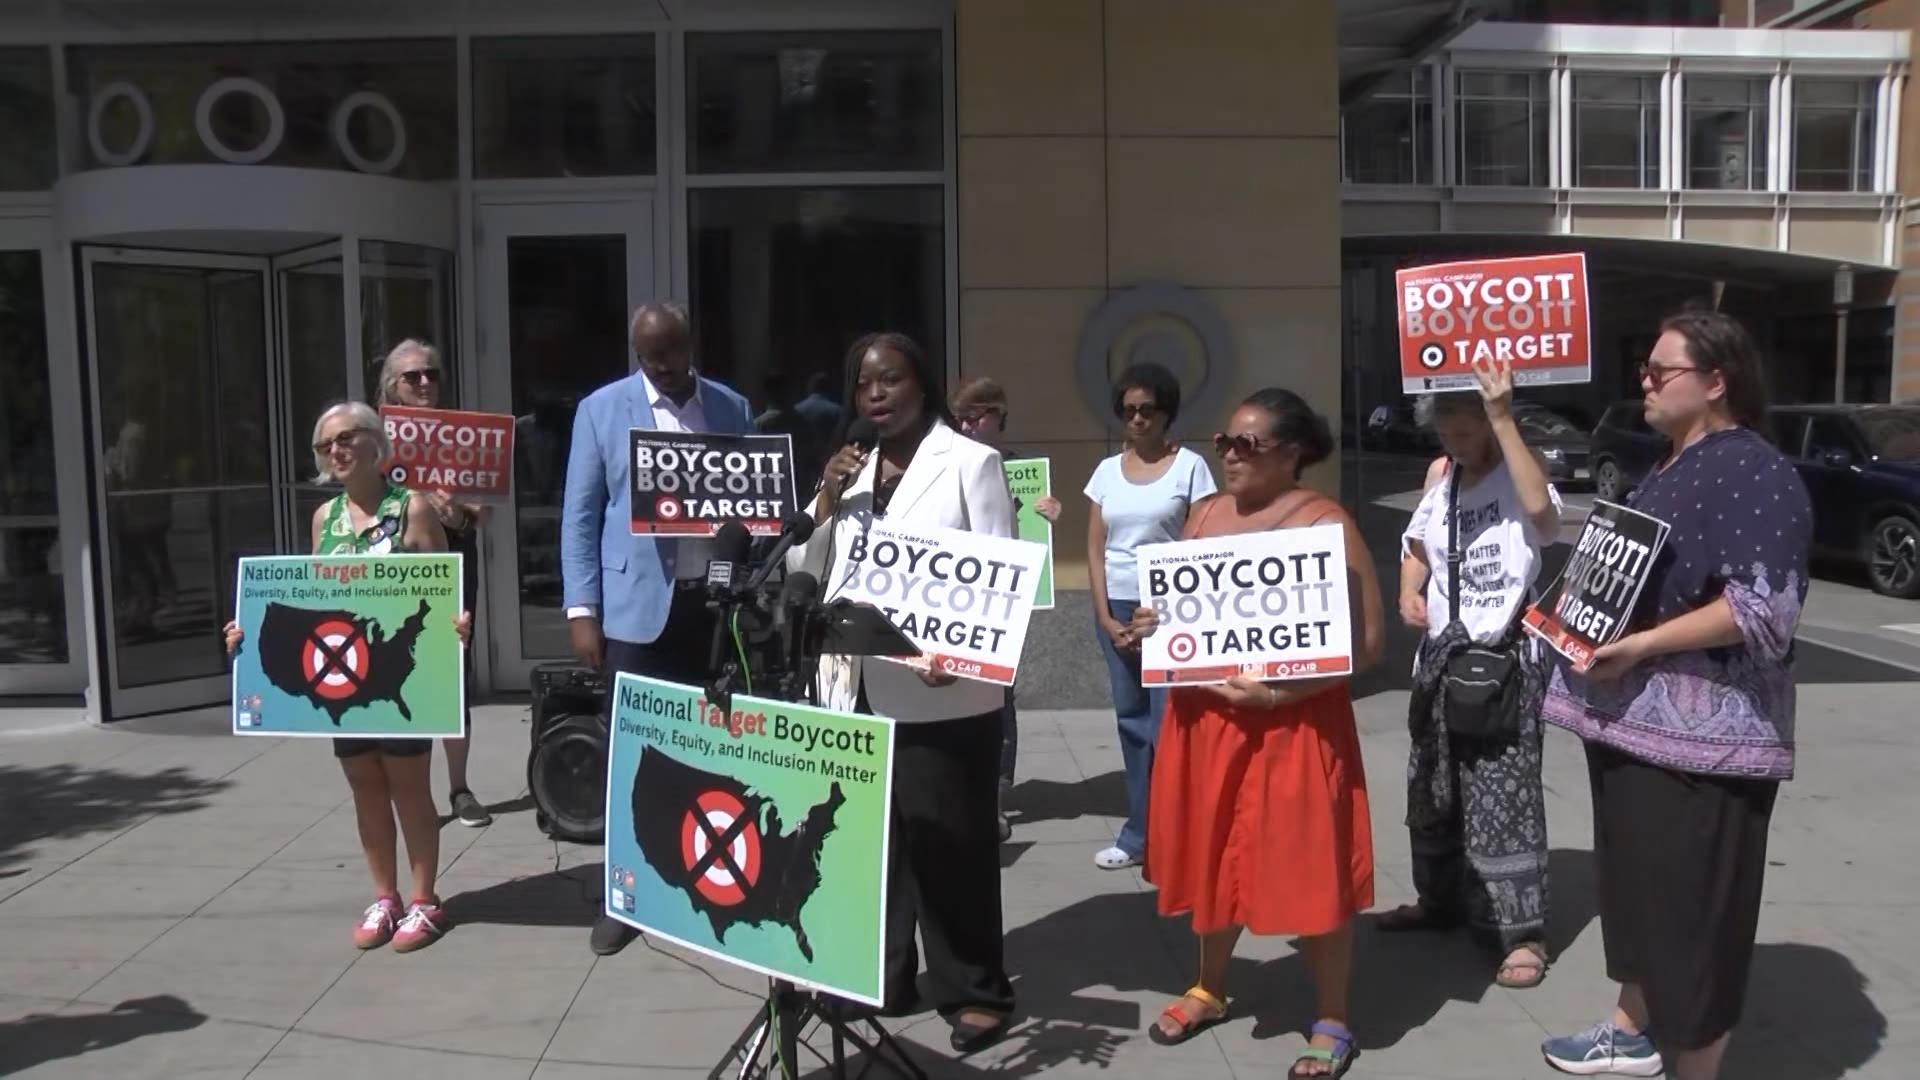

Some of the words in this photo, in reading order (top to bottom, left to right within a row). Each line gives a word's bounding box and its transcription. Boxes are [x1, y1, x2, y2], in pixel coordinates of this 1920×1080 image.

[1404, 273, 1574, 312] BOYCOTT
[1406, 300, 1576, 338] BOYCOTT
[1454, 332, 1572, 364] TARGET
[384, 420, 506, 448] BOYCOTT
[636, 447, 784, 473] BOYCOTT
[1006, 468, 1038, 482] cott
[415, 466, 500, 488] TARGET
[637, 468, 784, 494] BOYCOTT
[683, 499, 784, 518] TARGET
[858, 526, 895, 538] NIONAL
[898, 534, 940, 548] CAMPAIGN
[1469, 544, 1501, 560] MATTER
[1577, 524, 1650, 576] BOYCOTT
[244, 563, 308, 581] National
[312, 562, 368, 584] Target
[374, 562, 450, 584] Boycott
[848, 535, 1028, 592] BOYCOTT
[1150, 556, 1190, 566] NATIONAL
[1192, 551, 1234, 562] CAMPAIGN
[1150, 551, 1332, 596] BOYCOTT
[244, 587, 290, 600] Diversity,
[292, 588, 329, 600] Equity,
[330, 588, 352, 598] and
[354, 586, 406, 598] Inclusion
[410, 585, 453, 597] Matter
[842, 562, 1021, 620] BOYCOTT
[1564, 552, 1636, 608] BOYCOTT
[1152, 582, 1333, 626] BOYCOTT
[1560, 594, 1614, 643] TARGET
[882, 606, 1006, 653] TARGET
[1202, 621, 1331, 656] TARGET
[1292, 662, 1316, 674] CAIR
[620, 685, 692, 722] National
[774, 715, 876, 756] Boycott
[619, 717, 668, 746] Diversity,
[672, 729, 714, 756] Equity,
[718, 740, 744, 760] and
[748, 746, 816, 773] Inclusion
[820, 759, 877, 784] Matter
